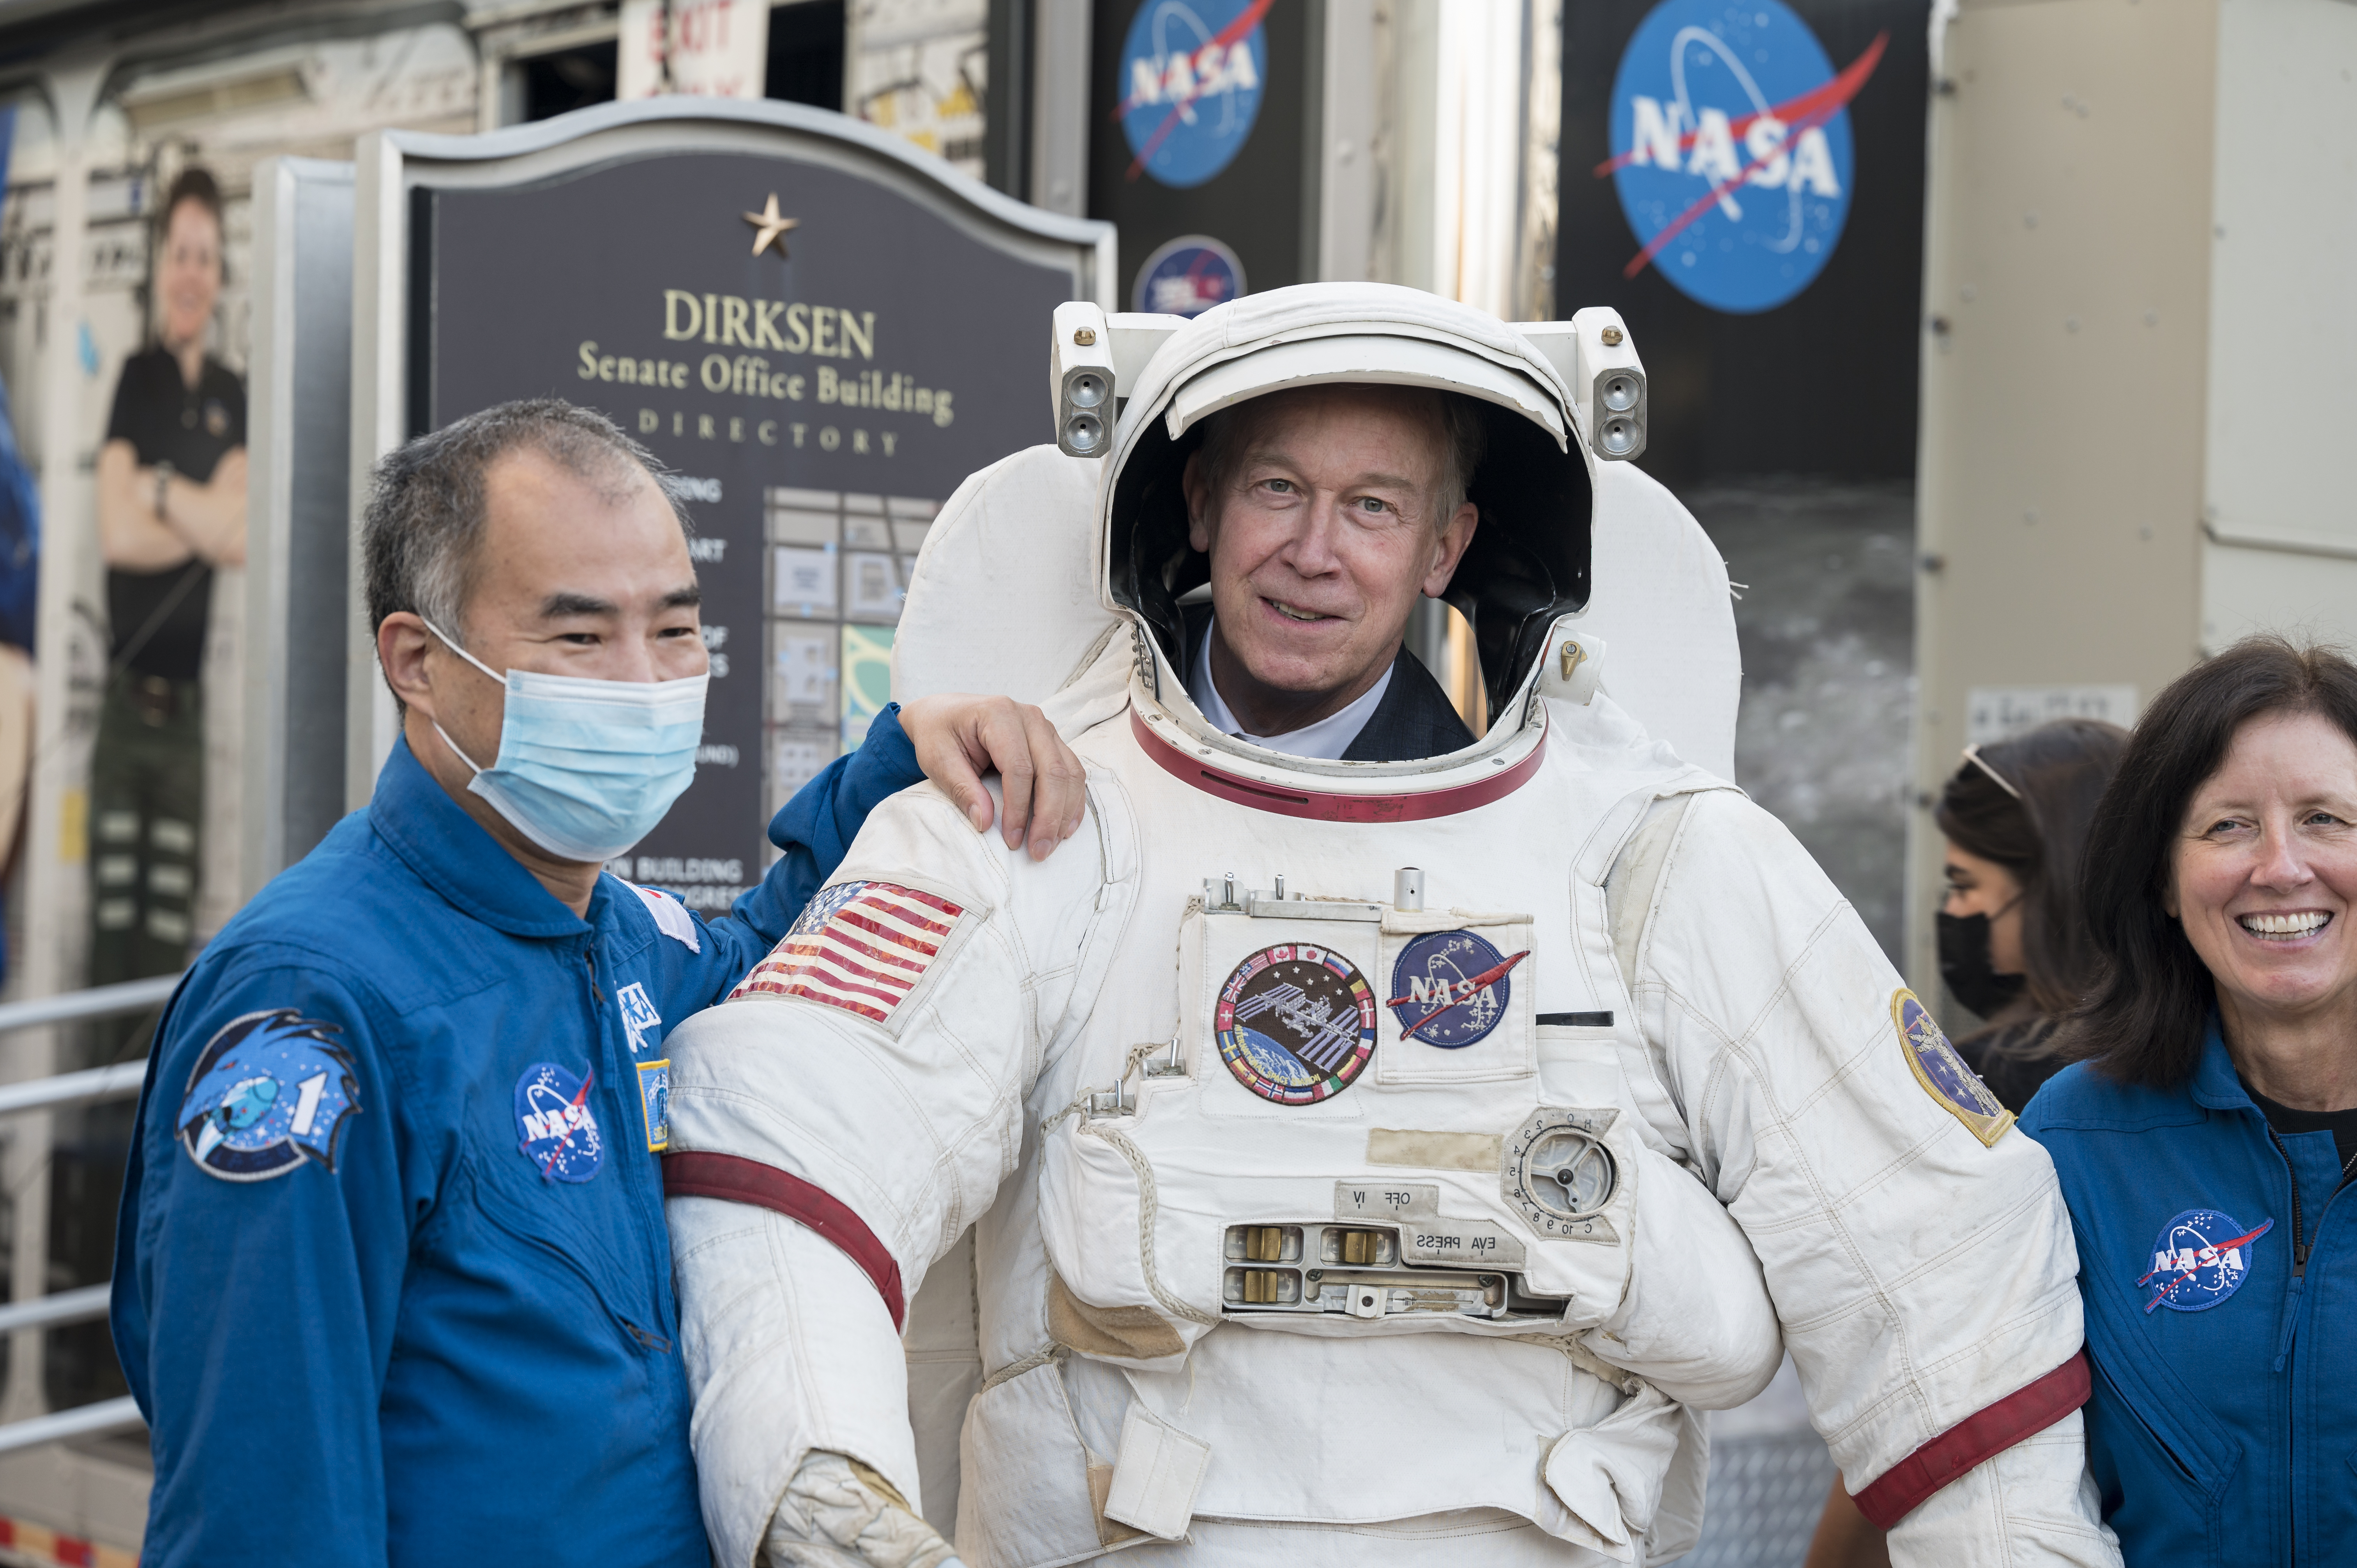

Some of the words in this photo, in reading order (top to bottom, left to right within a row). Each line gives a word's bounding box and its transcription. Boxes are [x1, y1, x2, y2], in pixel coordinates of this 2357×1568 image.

[1132, 40, 1258, 108] NASA
[1631, 95, 1842, 200] NASA
[664, 289, 878, 361] DIRKSEN
[577, 340, 689, 389] Senate
[700, 353, 806, 401] Office
[817, 365, 954, 428] Building
[639, 408, 898, 457] DIRECTORY
[637, 856, 743, 883] BUILDING
[1408, 976, 1499, 1008] NASA
[1234, 1024, 1265, 1074] INTERNATIONAL
[1267, 1071, 1288, 1085] SPACE
[1292, 1074, 1321, 1086] STATION
[290, 1072, 328, 1136] 1
[522, 1104, 597, 1142] NASA
[2153, 1248, 2244, 1273] NASA
